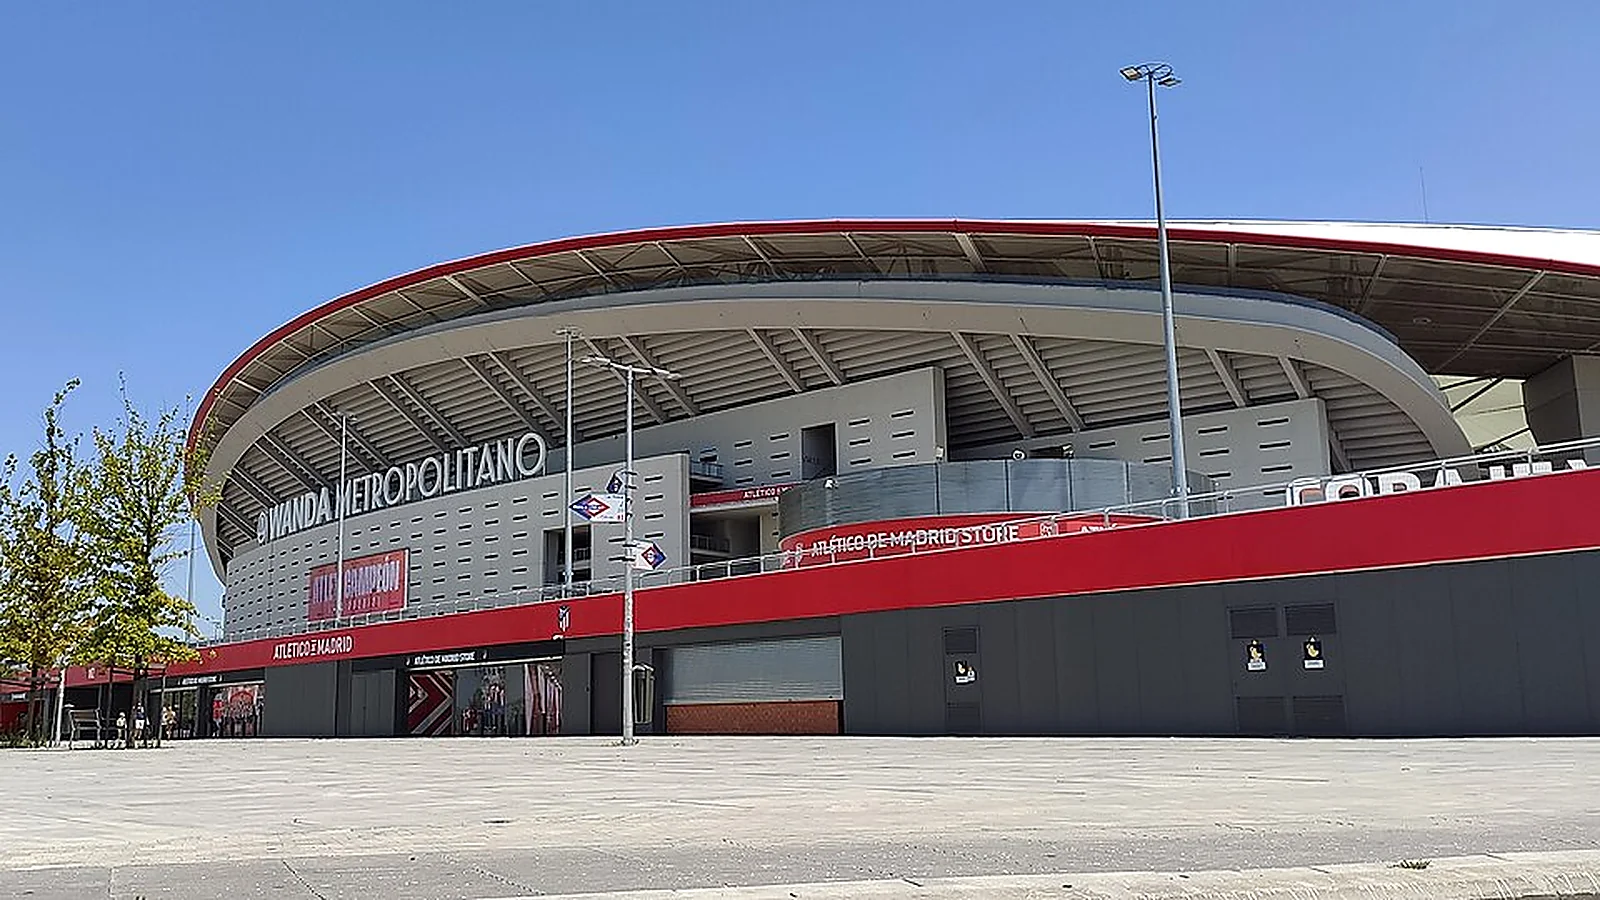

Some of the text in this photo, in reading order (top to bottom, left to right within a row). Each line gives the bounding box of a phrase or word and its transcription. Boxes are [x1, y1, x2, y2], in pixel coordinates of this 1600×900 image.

[269, 432, 547, 540] WANDA METROPOLITANO
[811, 525, 1019, 557] ATLÉTICO DE MADRID STORE
[318, 635, 353, 655] MADRID
